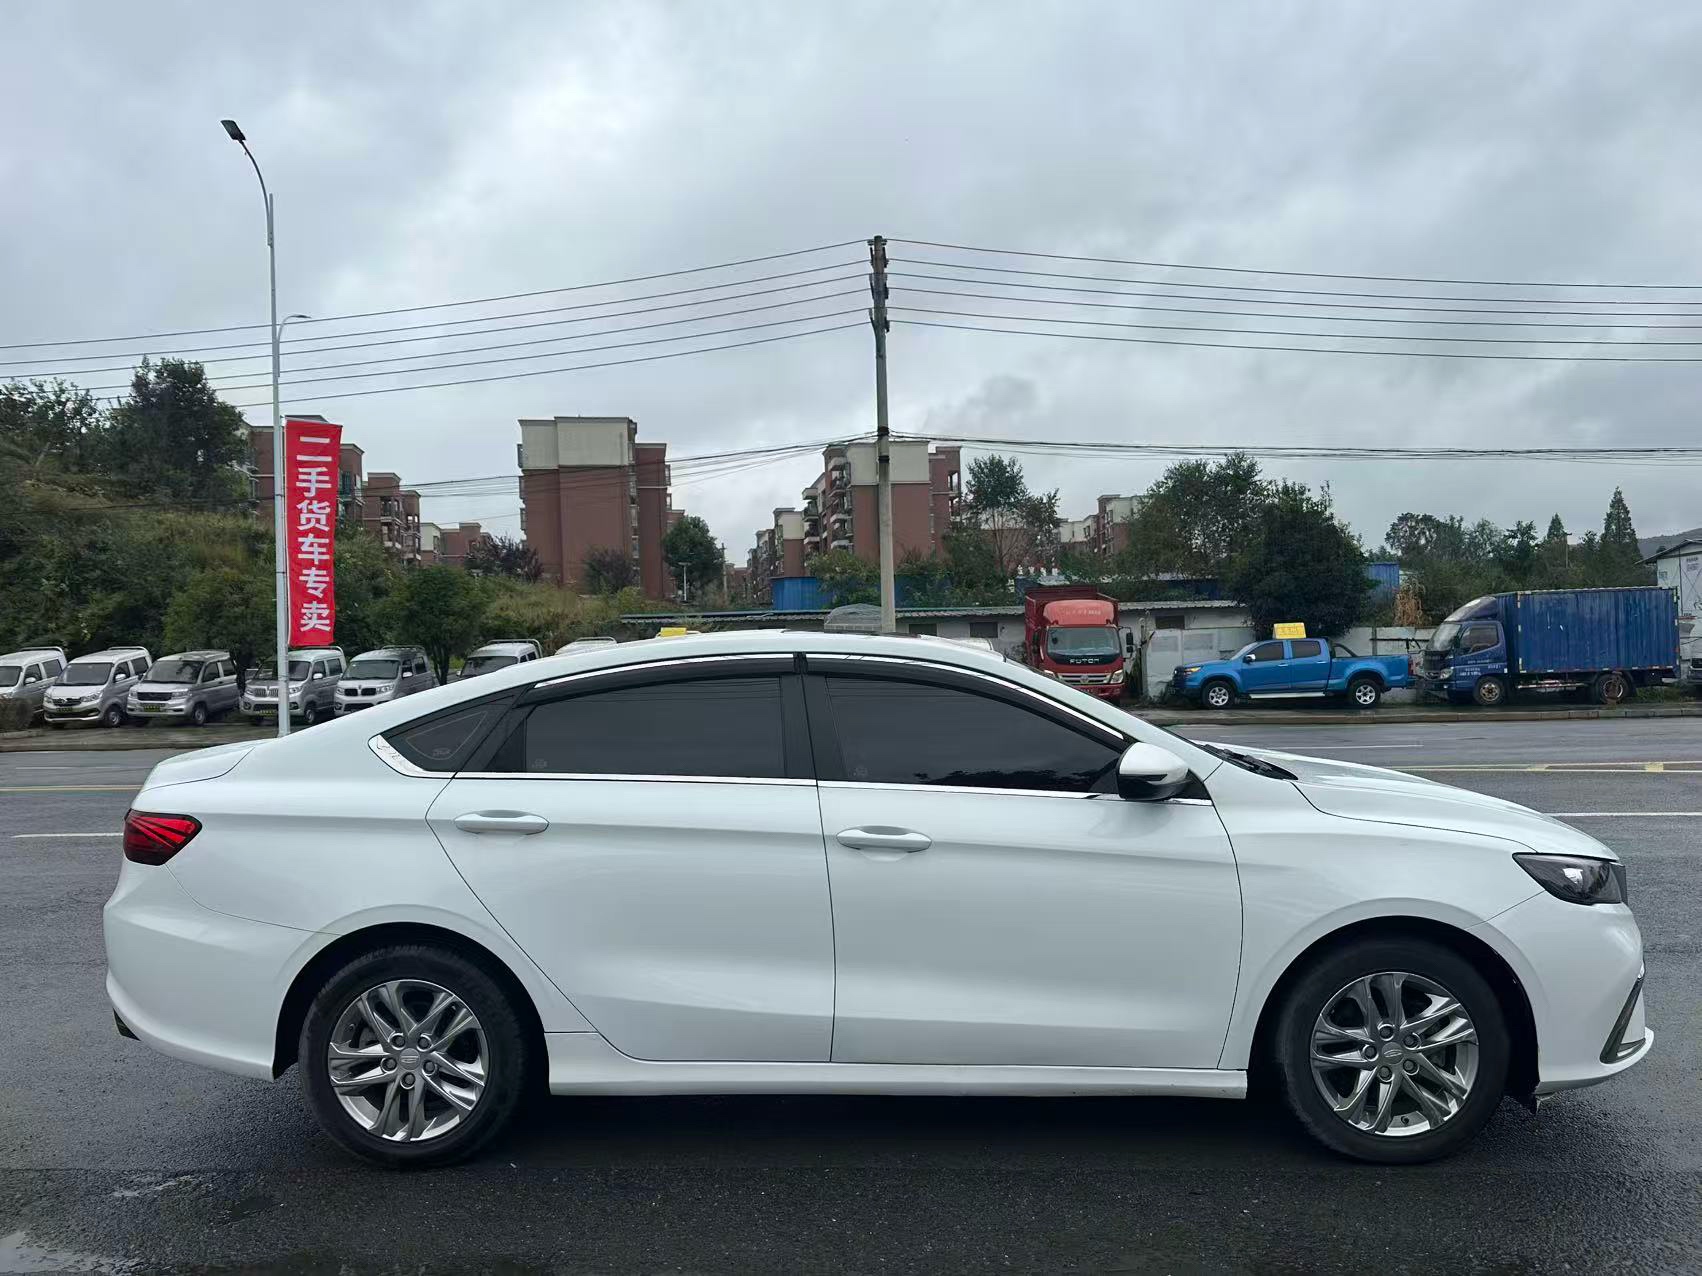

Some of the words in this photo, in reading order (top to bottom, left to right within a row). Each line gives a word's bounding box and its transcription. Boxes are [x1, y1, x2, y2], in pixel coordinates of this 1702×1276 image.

[296, 436, 332, 632] 二手货车专卖
